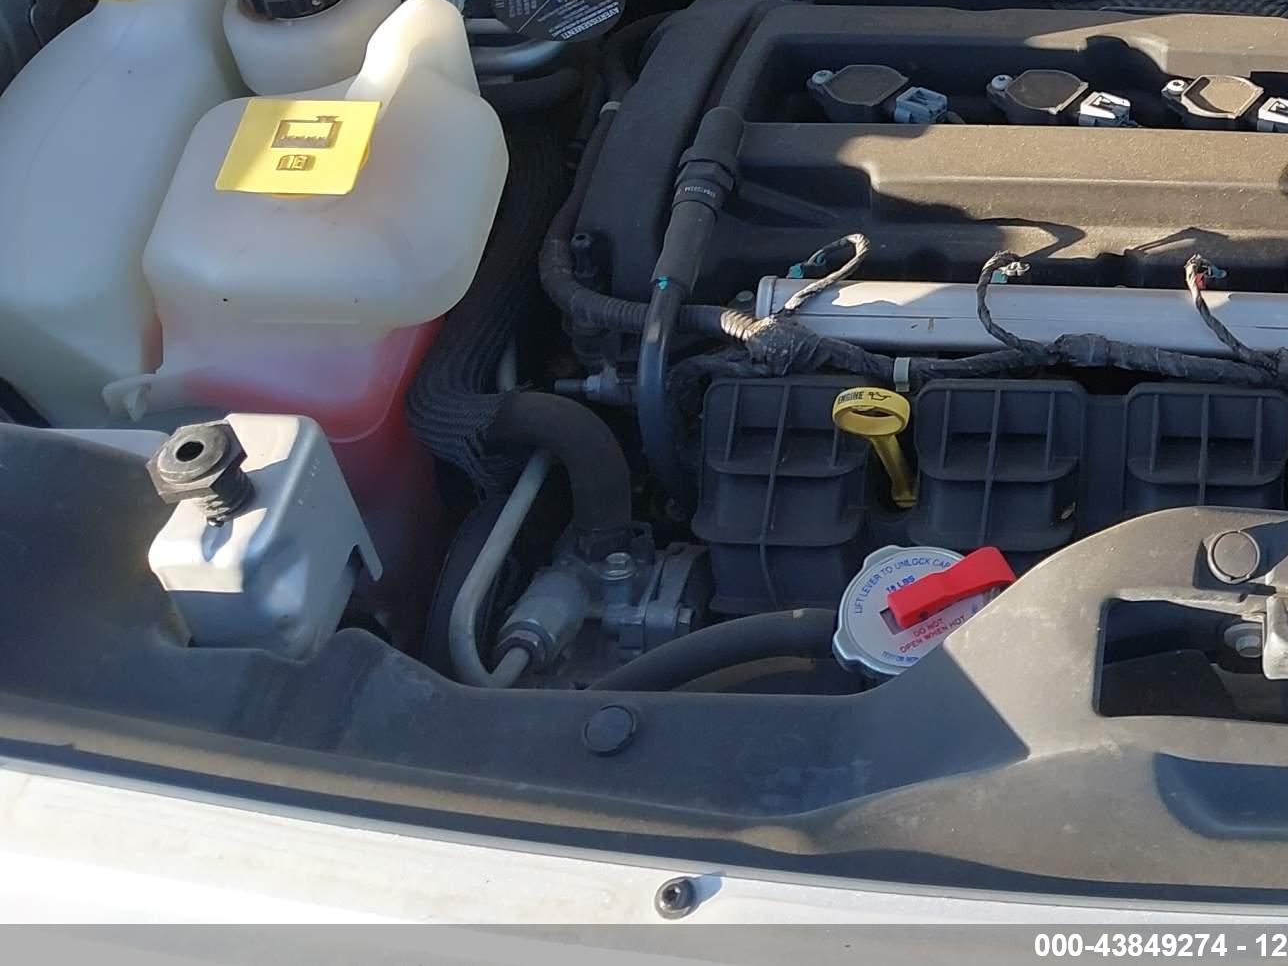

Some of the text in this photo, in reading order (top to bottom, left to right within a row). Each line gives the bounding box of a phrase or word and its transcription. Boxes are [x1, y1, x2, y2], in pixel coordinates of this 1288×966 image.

[837, 391, 865, 404] ENGINE
[854, 597, 865, 614] LIFT
[862, 573, 882, 598] LEVER
[880, 565, 893, 575] TO
[894, 557, 931, 570] UNLOCK
[899, 615, 967, 654] OPEN WHEN HOT
[913, 617, 945, 637] DO NOT
